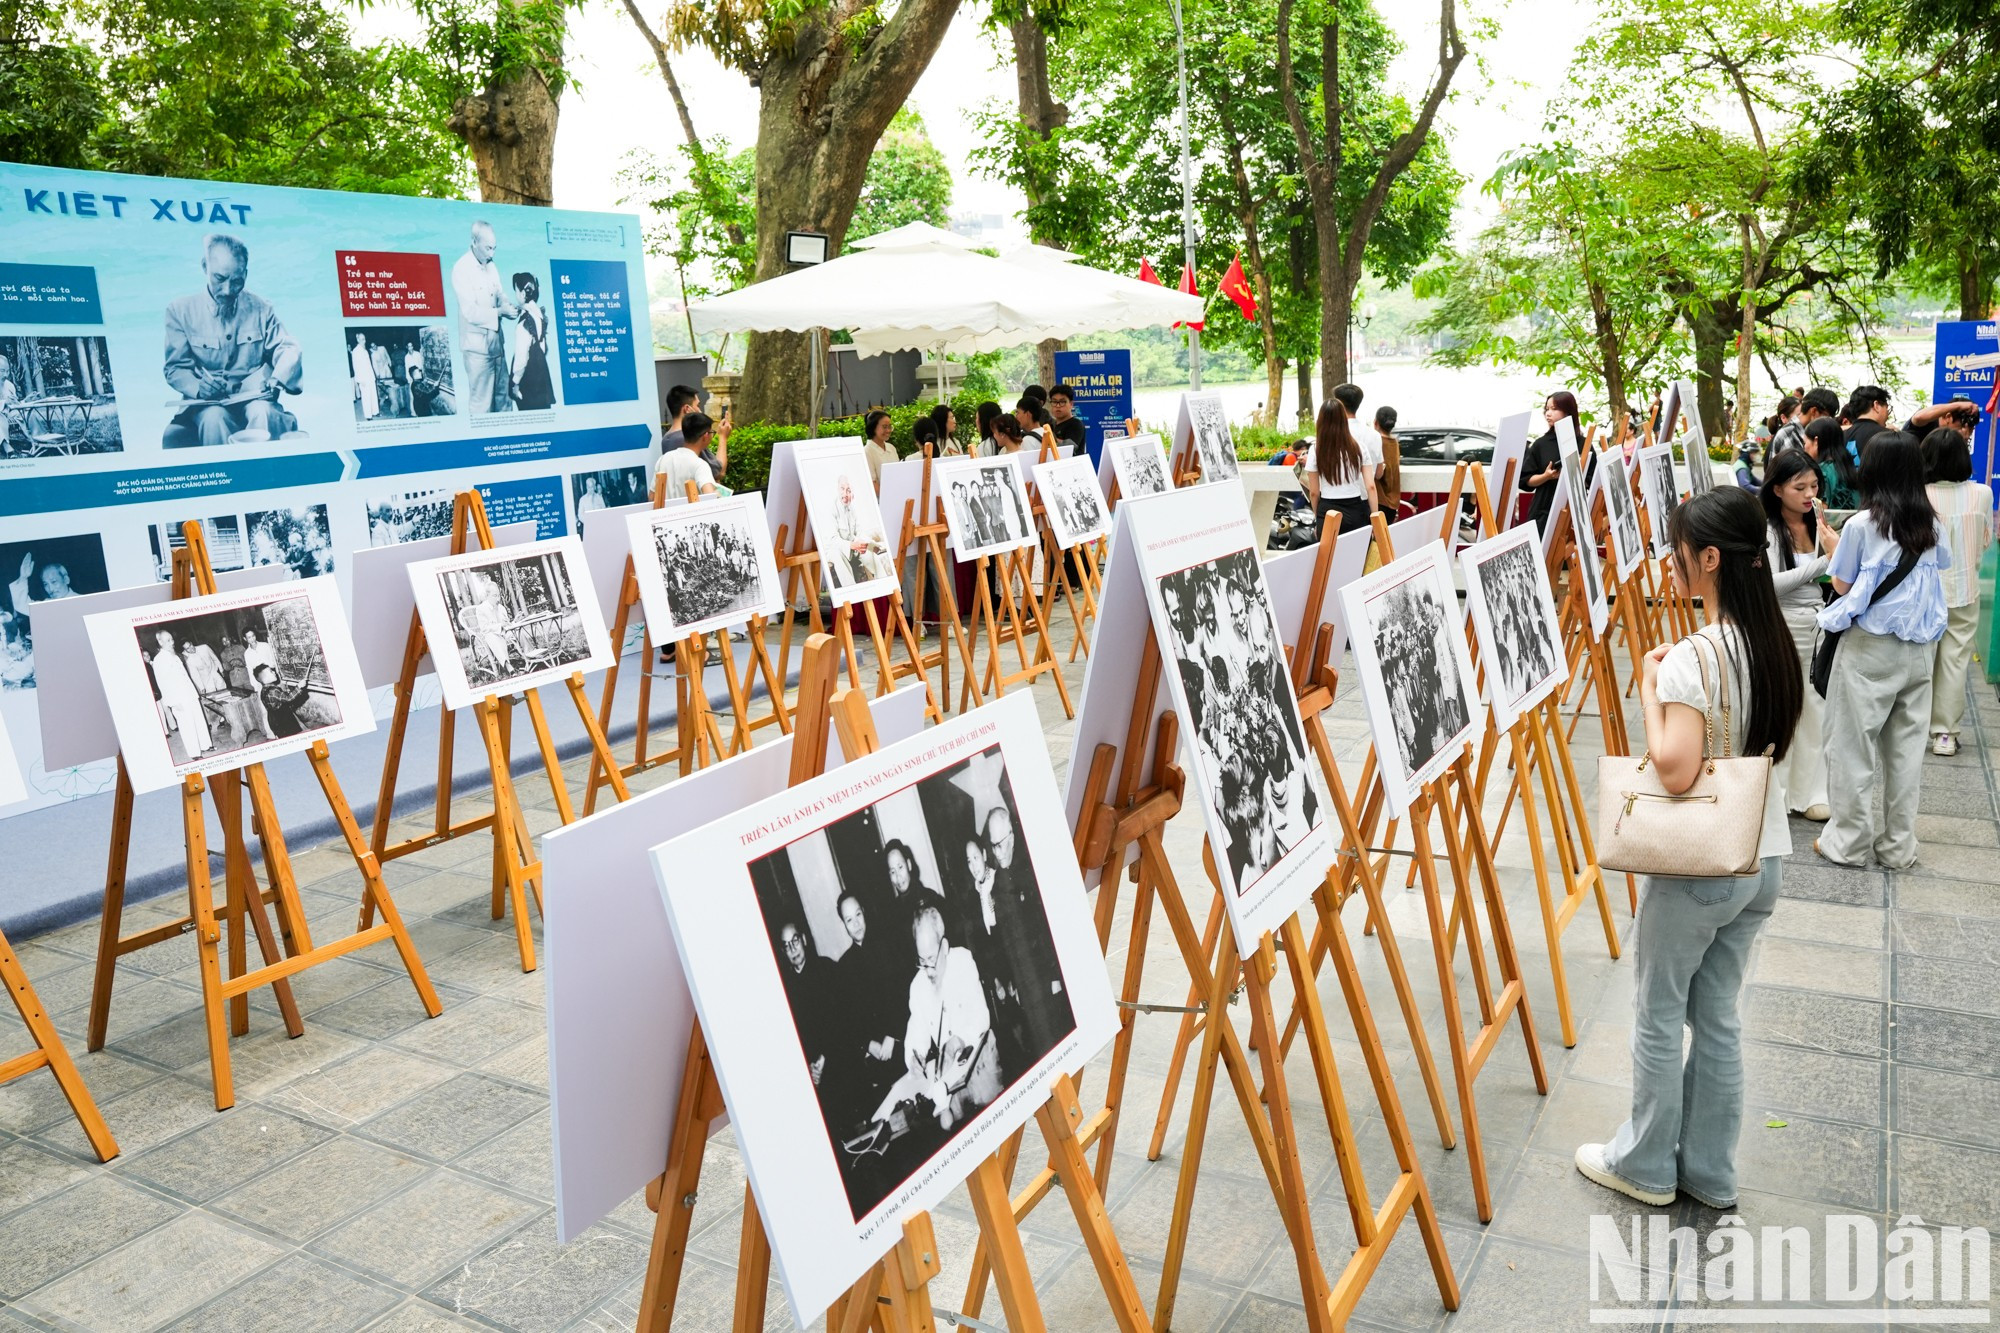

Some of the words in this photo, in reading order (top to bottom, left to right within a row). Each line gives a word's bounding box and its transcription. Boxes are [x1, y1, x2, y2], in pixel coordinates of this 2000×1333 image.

[150, 197, 251, 225] XUẤT
[346, 270, 361, 278] Trẻ
[21, 285, 36, 293] đất
[347, 281, 362, 289] búp
[349, 291, 368, 299] Biết
[386, 291, 403, 300] ngủ,
[408, 291, 425, 299] biết
[350, 302, 364, 311] học
[405, 303, 430, 311] ngoan.
[1062, 374, 1088, 387] QUÉT
[1090, 373, 1106, 386] MÃ
[1108, 375, 1122, 386] QR
[1945, 369, 1961, 382] ĐỂ
[1964, 369, 1990, 382] TRẢI
[1074, 388, 1091, 397] TRẢI
[1093, 387, 1122, 398] NGHIỆM
[739, 825, 770, 846] TRIỂN
[770, 815, 792, 833] LÃM
[793, 805, 812, 822] ẢNH
[813, 796, 826, 813] KỶ
[827, 788, 850, 805] NIỆM
[850, 782, 863, 796] 135
[863, 775, 882, 790] NĂM
[882, 763, 904, 781] NGÀY
[904, 756, 921, 771] SINH
[922, 745, 937, 762] CHỦ
[938, 740, 955, 756] TỊCH
[955, 735, 966, 748] HỒ
[966, 729, 979, 742] CHÍ
[979, 721, 997, 737] MINH
